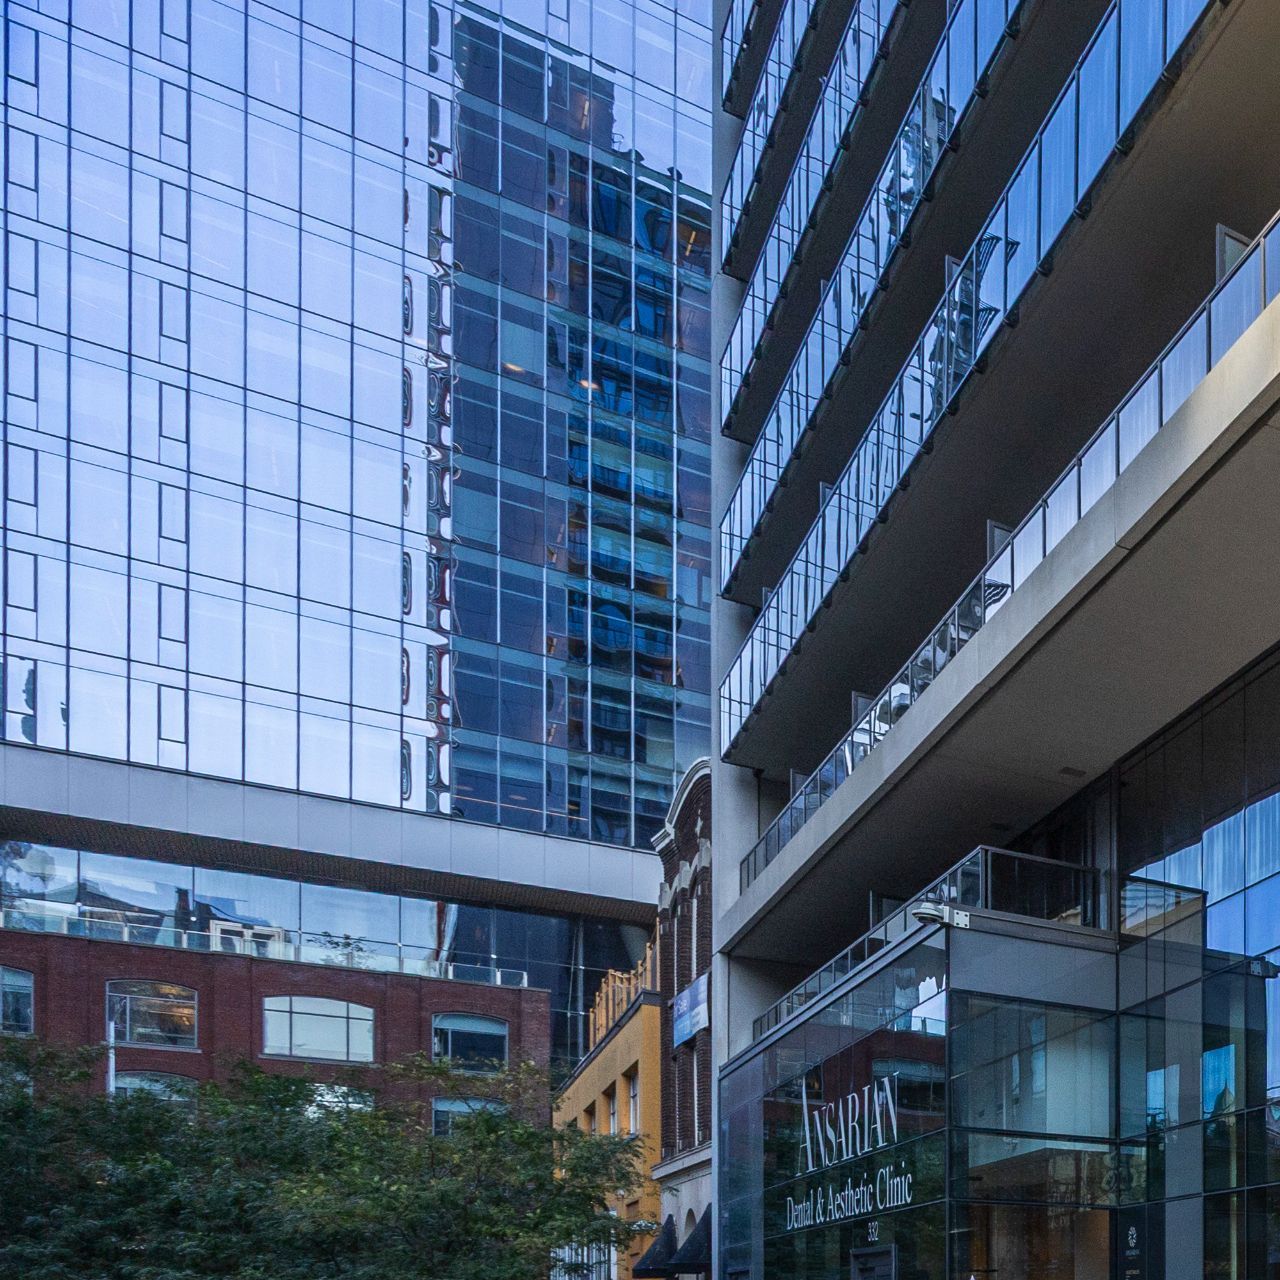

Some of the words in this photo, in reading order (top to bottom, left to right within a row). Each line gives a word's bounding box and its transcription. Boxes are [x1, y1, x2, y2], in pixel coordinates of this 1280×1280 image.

[795, 1071, 900, 1177] ANSARIAN
[786, 1187, 814, 1230] Dental
[815, 1186, 825, 1223] &
[826, 1172, 874, 1222] Aesthetic
[876, 1161, 913, 1210] Clinic
[867, 1221, 879, 1242] 332
